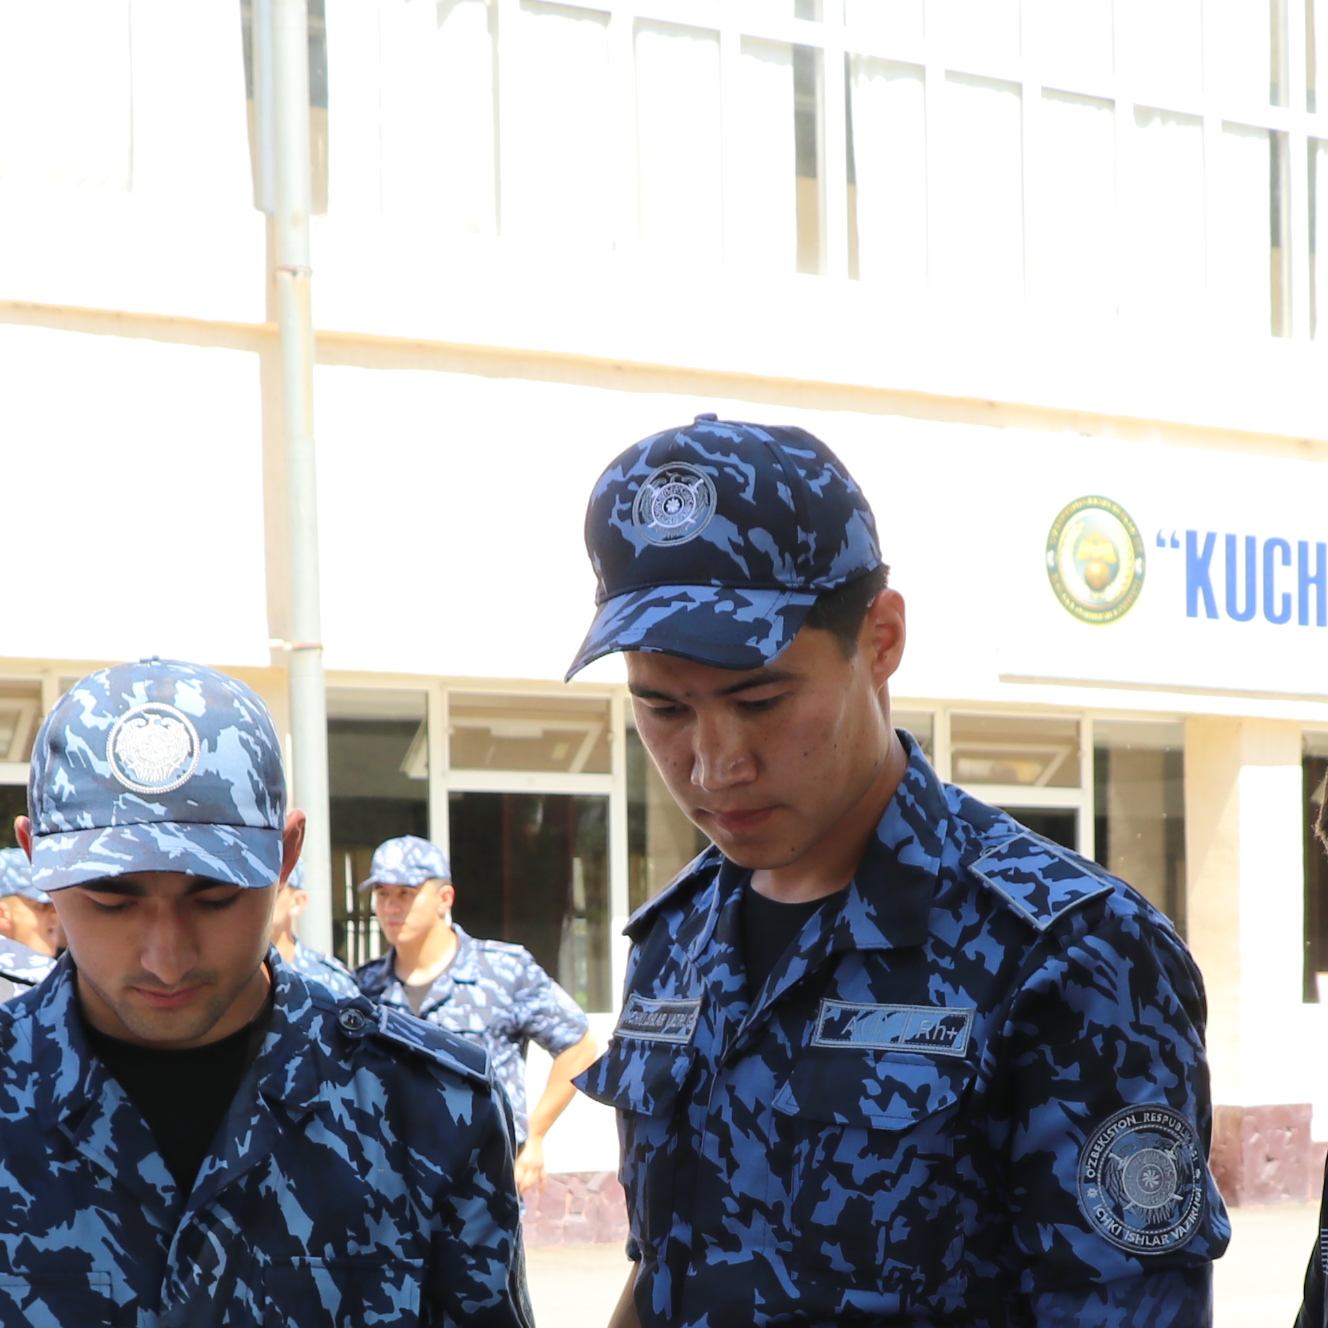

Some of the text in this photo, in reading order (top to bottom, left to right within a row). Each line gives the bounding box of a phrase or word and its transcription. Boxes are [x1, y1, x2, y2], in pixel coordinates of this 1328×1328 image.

[915, 1017, 958, 1043] Rh+
[1093, 1188, 1202, 1246] ICHKI ISHLAR VAZIRLIGI
